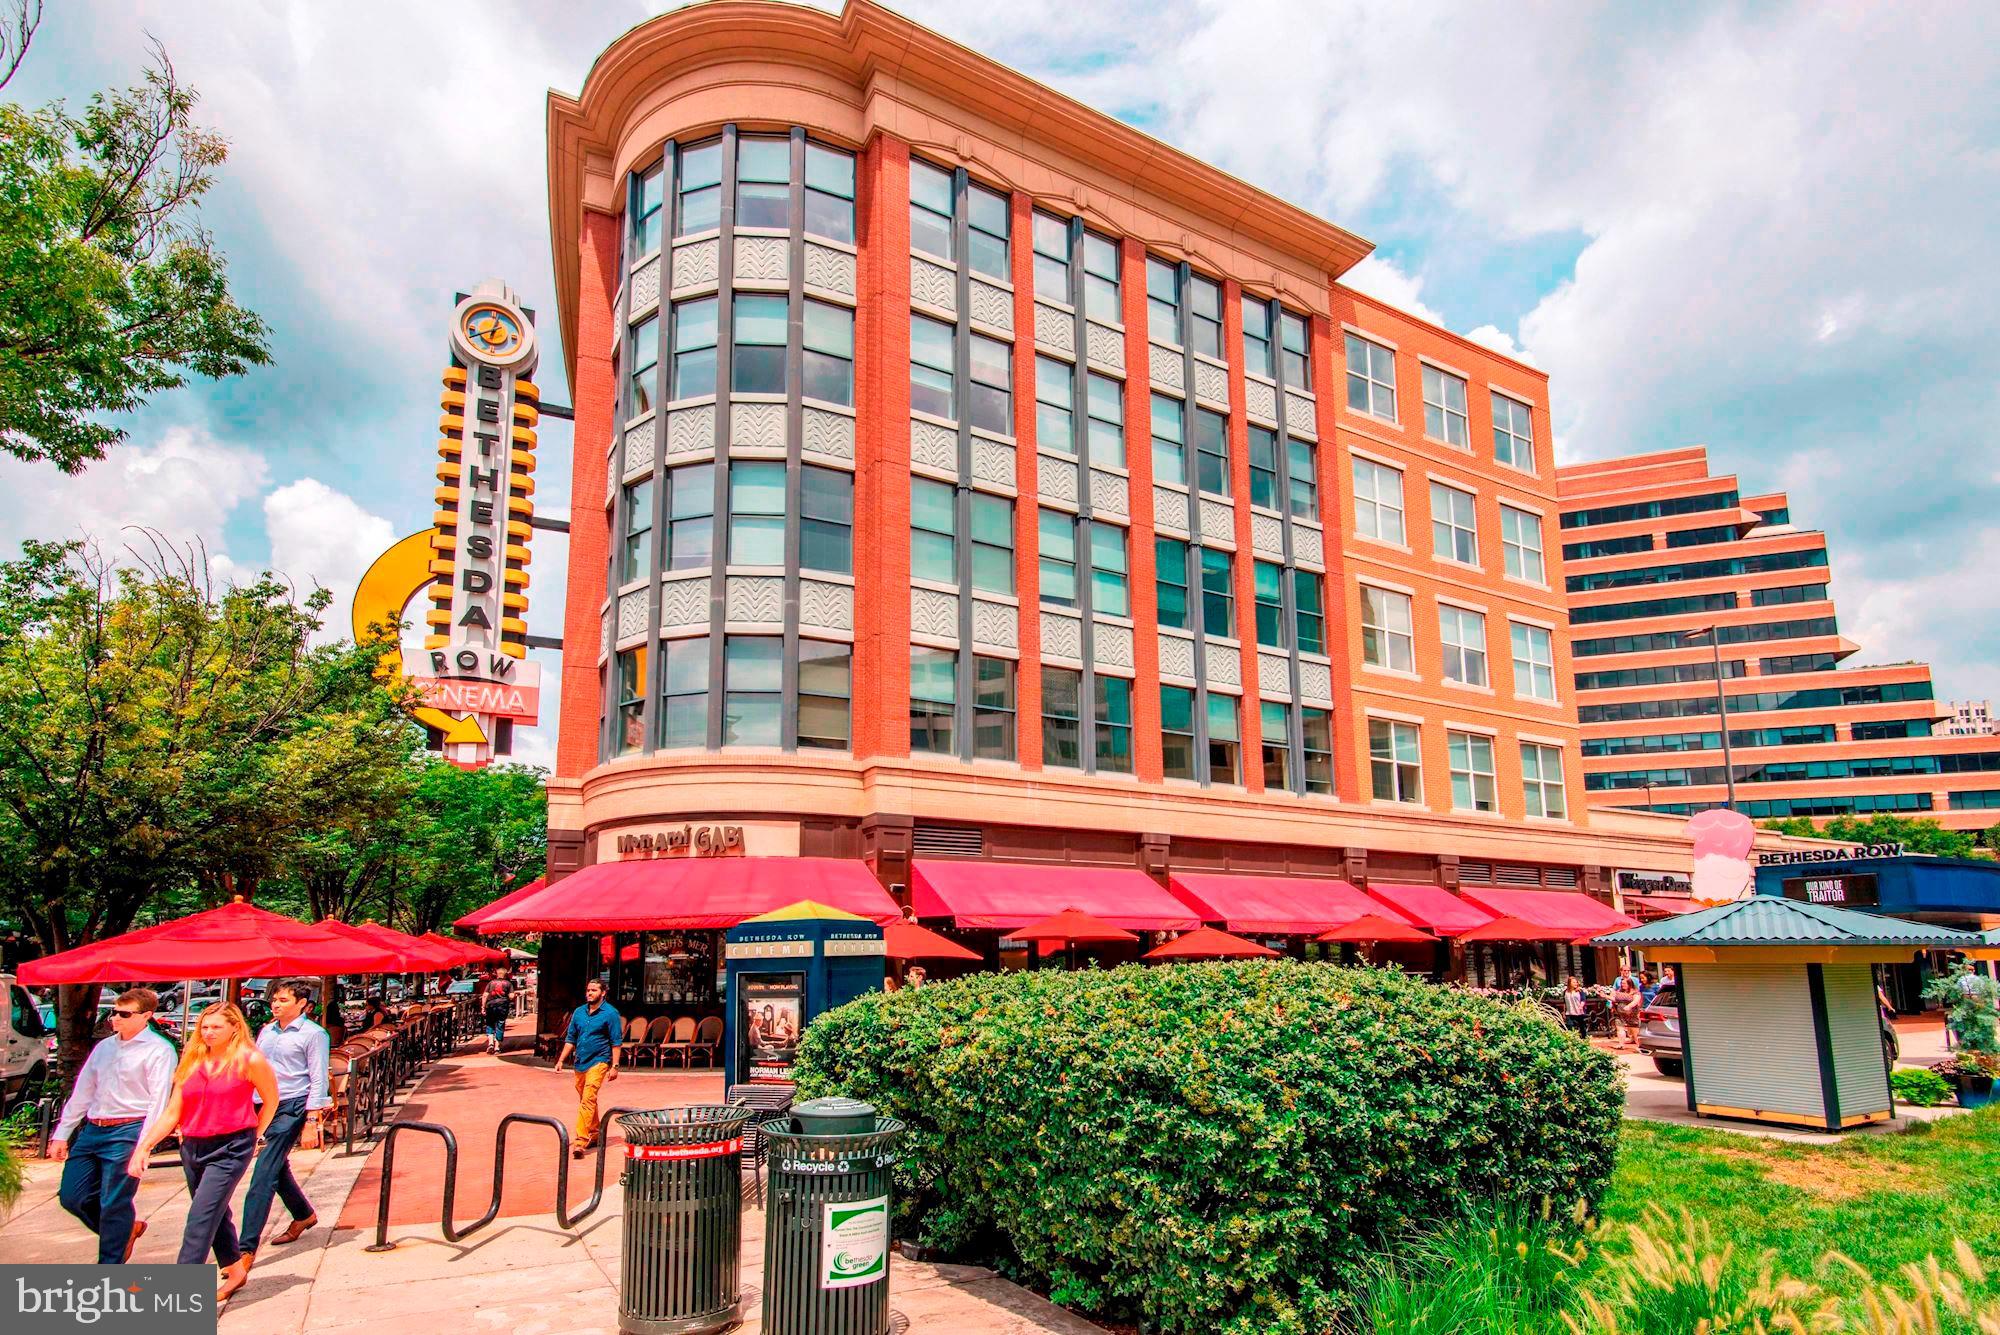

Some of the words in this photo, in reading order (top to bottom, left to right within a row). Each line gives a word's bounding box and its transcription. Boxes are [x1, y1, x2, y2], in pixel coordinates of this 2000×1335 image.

[458, 363, 503, 630] BETHESDA
[430, 650, 515, 677] ROW
[1758, 848, 1850, 865] BETHESDA
[1851, 843, 1904, 859] ROW
[1806, 881, 1818, 891] OUR
[1819, 880, 1834, 890] KIND
[1834, 879, 1843, 890] OF
[1808, 889, 1845, 902] TRAITOR
[739, 934, 782, 942] BETHESDA
[732, 944, 805, 956] CINEMA
[833, 942, 885, 953] CINEMA
[648, 1146, 724, 1157] www.bethesda.org
[793, 1161, 834, 1174] Recycle
[844, 1254, 873, 1265] bethesda
[852, 1261, 870, 1269] green
